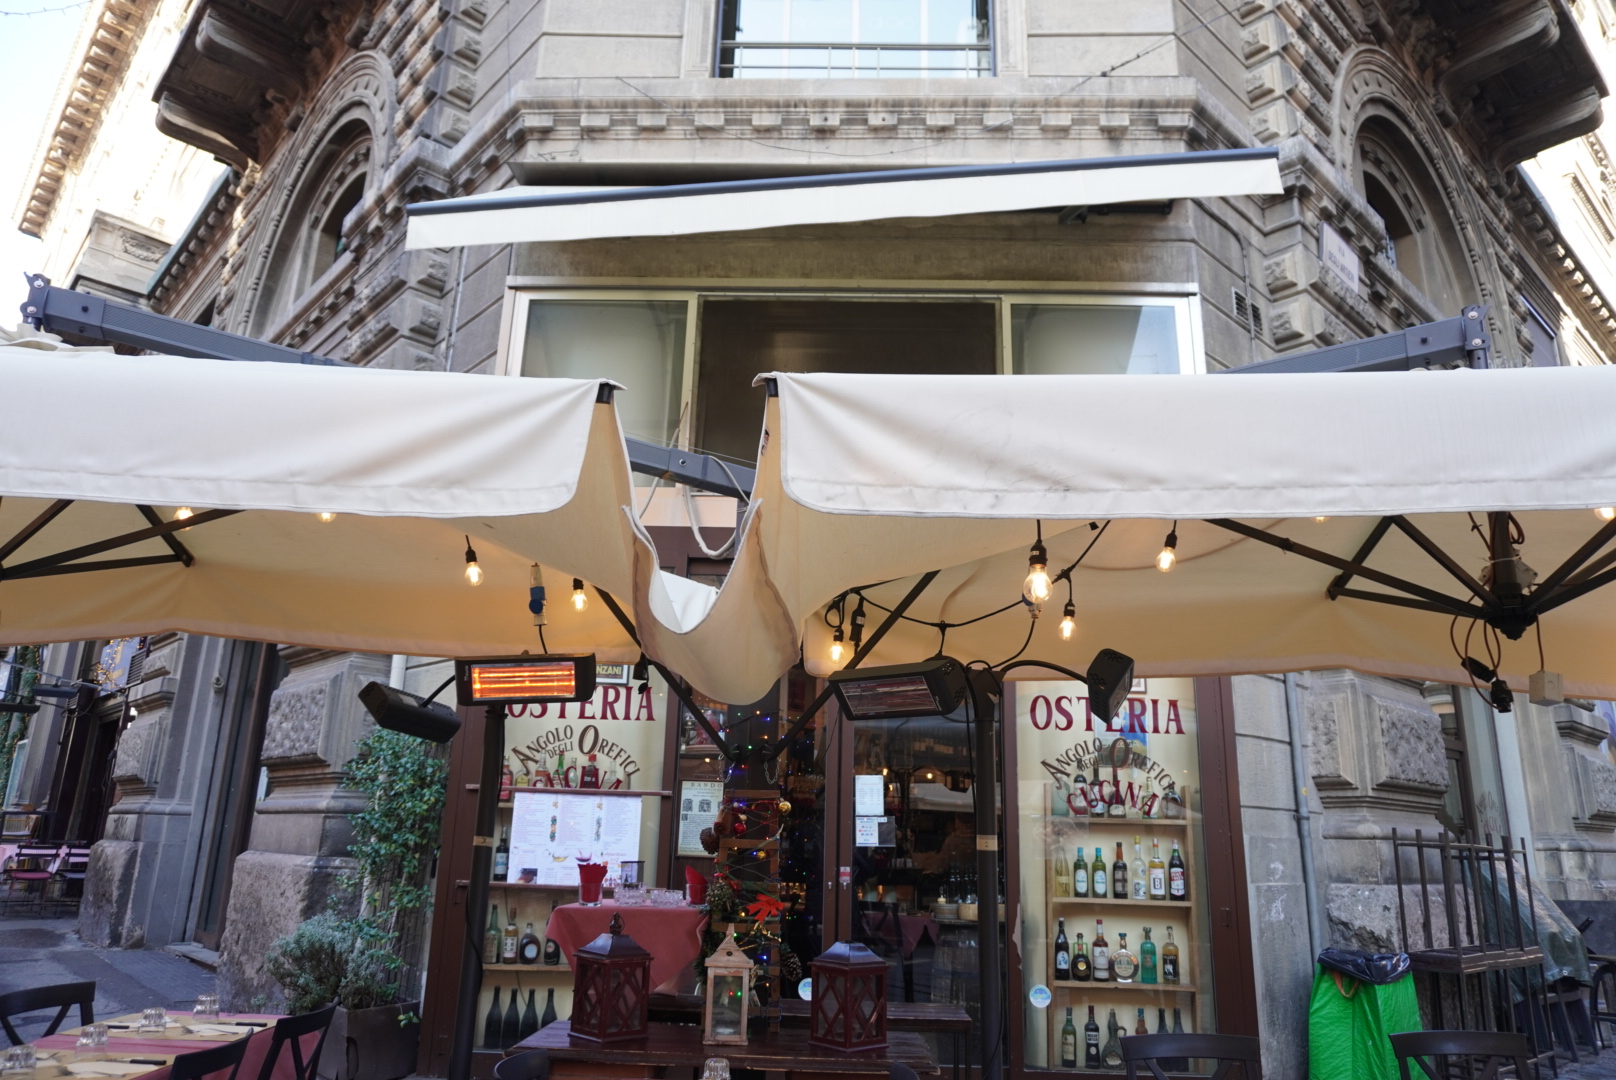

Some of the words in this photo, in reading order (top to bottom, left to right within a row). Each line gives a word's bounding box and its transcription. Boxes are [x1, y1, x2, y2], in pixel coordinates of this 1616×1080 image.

[511, 725, 574, 777] ANGOLO
[547, 741, 573, 760] DEGLI
[578, 725, 642, 777] OREFICI
[1040, 737, 1103, 790] ANGOLO
[1109, 737, 1175, 792] OREFICI
[1066, 779, 1160, 818] CUCINA
